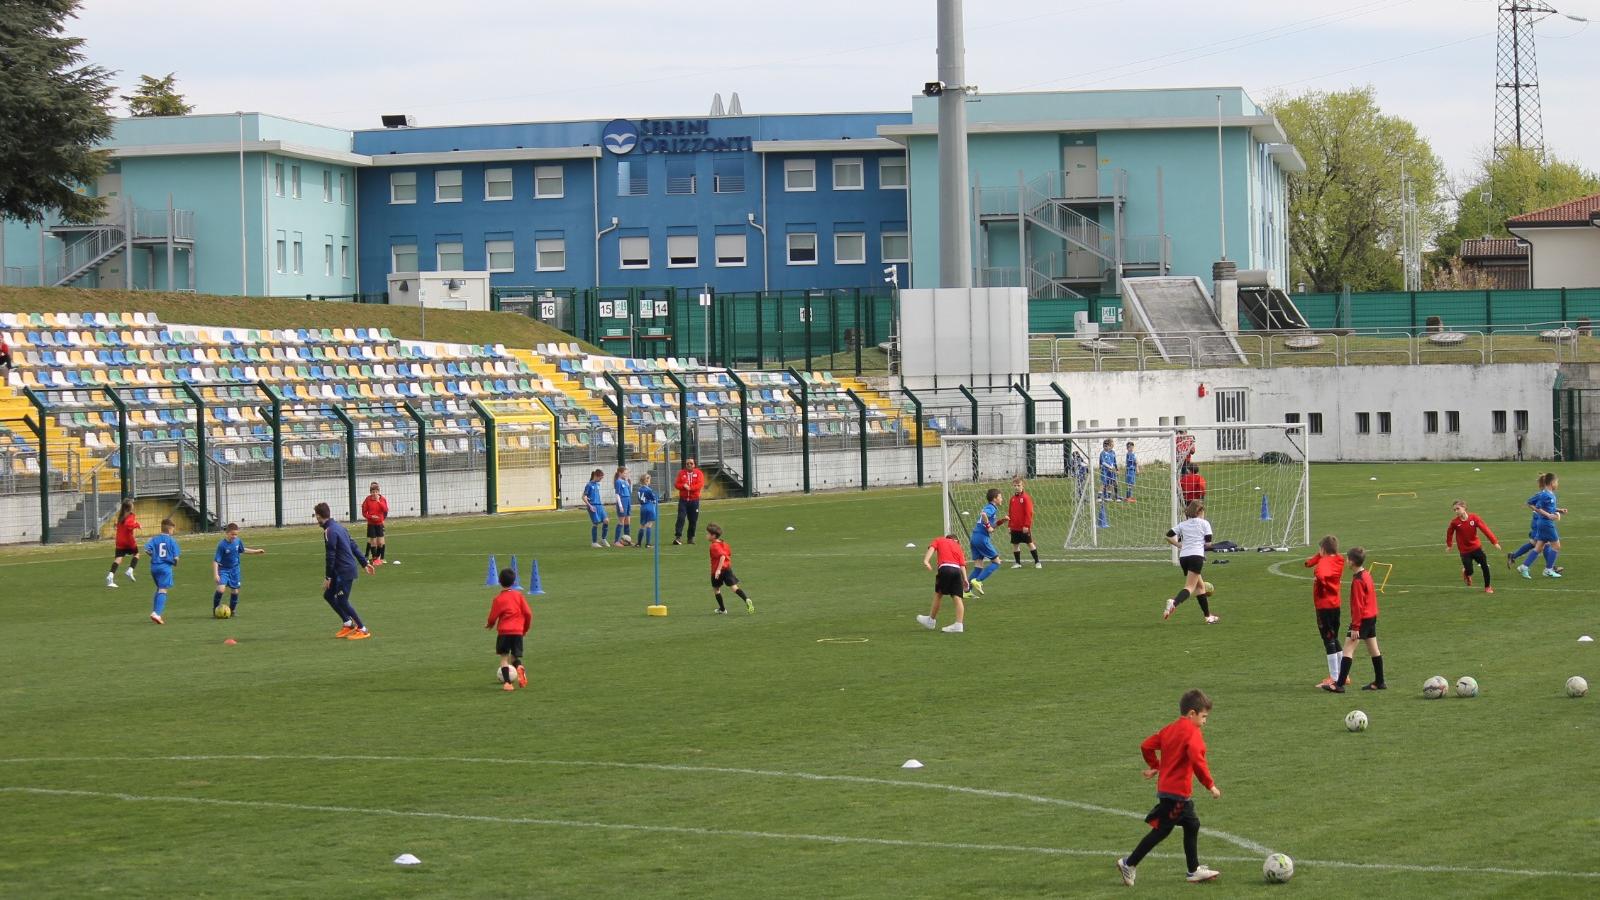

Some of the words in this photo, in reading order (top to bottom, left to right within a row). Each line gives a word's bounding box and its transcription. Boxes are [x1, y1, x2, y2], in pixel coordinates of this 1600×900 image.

[640, 119, 709, 135] SERENI
[640, 136, 751, 153] ORIZZONTI
[543, 305, 554, 315] 16
[600, 304, 612, 315] 15
[656, 303, 667, 313] 14
[159, 542, 167, 557] 6
